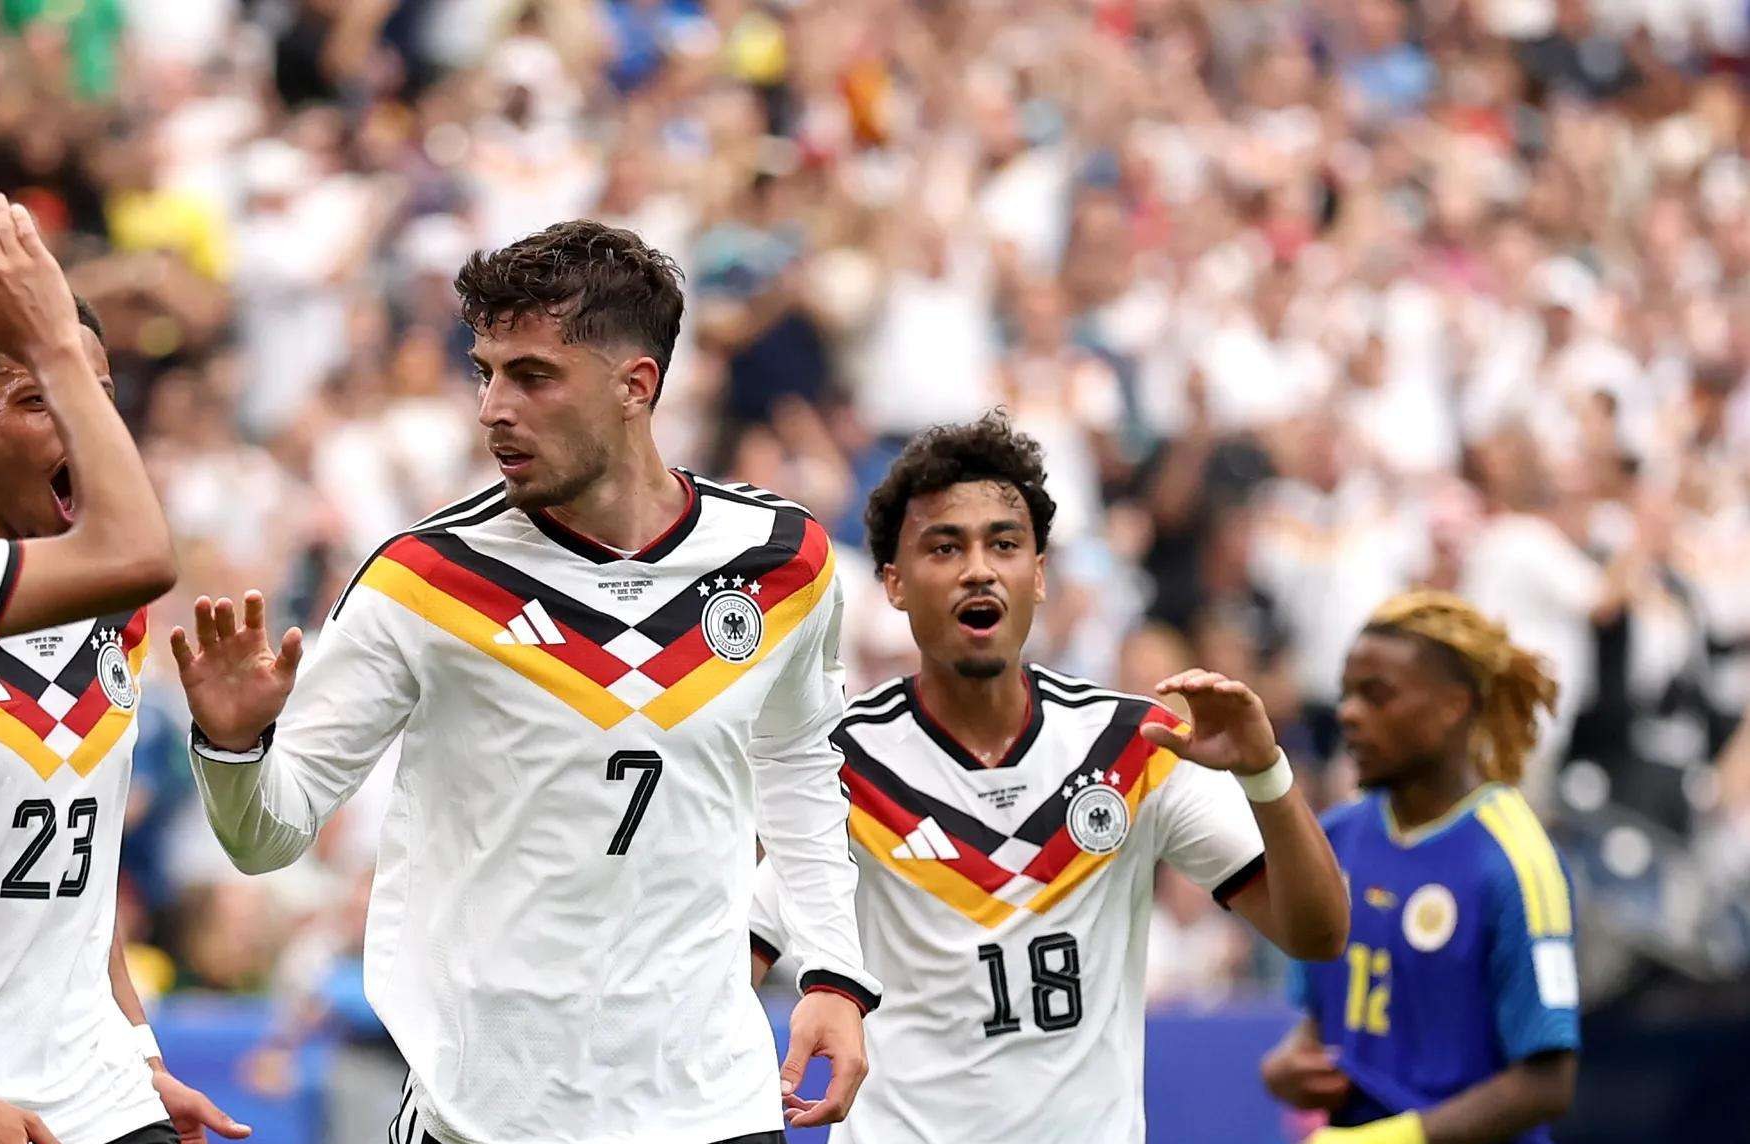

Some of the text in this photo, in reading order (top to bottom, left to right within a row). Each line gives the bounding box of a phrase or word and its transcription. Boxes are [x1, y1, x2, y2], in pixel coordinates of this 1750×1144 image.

[0, 797, 98, 900] 23
[606, 750, 663, 855] 7
[978, 931, 1083, 1038] 18
